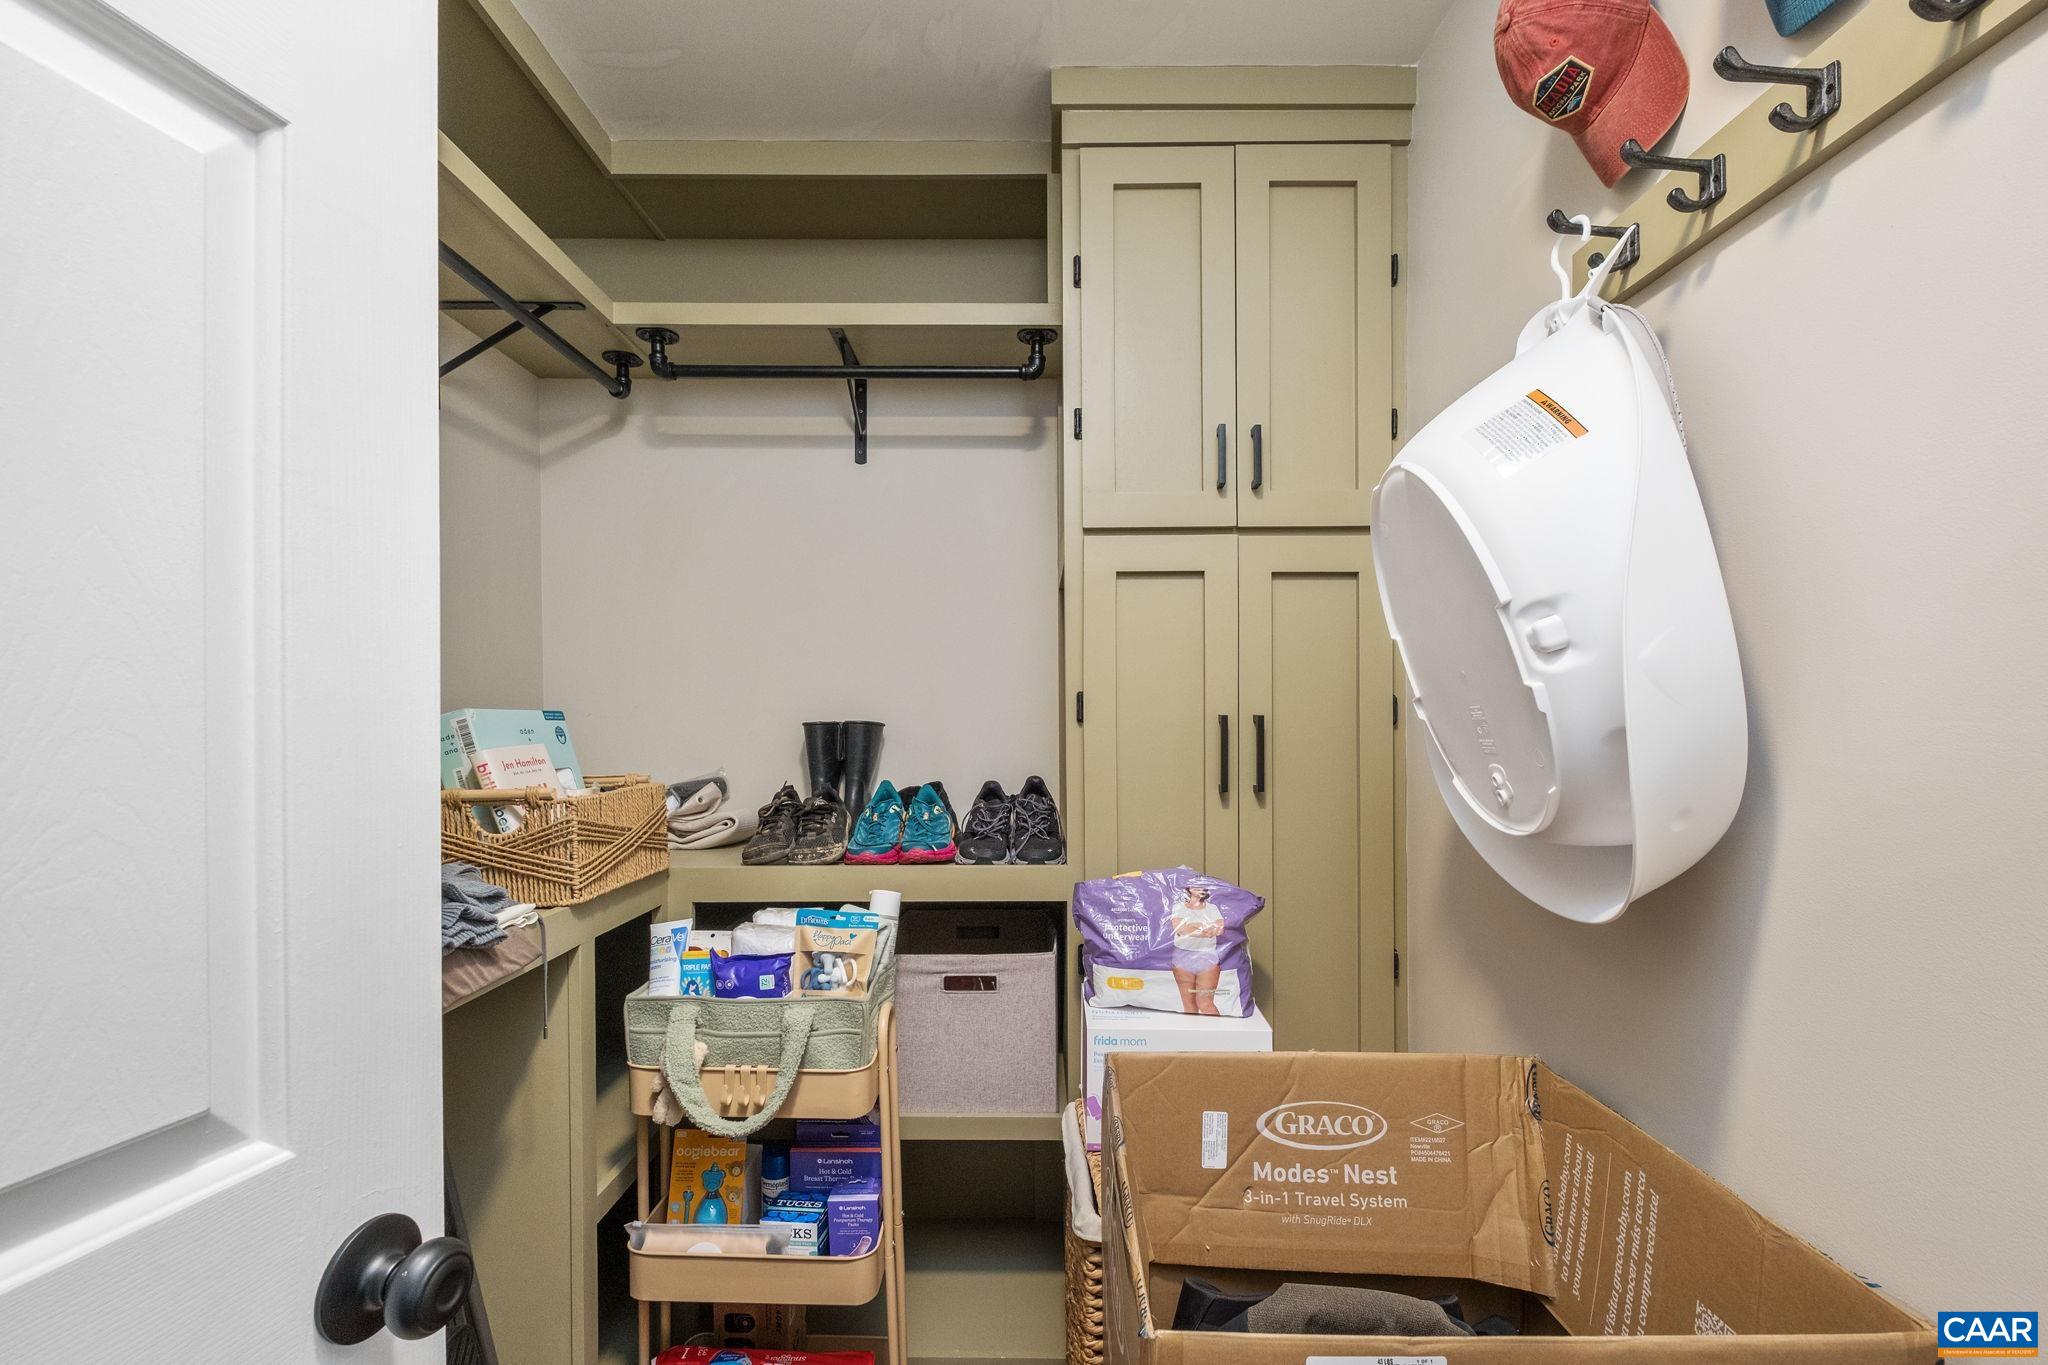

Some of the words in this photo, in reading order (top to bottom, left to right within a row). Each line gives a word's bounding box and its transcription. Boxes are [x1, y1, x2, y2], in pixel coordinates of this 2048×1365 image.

[1571, 70, 1587, 91] PARK
[1546, 400, 1573, 425] WARNING
[519, 727, 536, 735] aden
[502, 760, 515, 772] Jen
[514, 755, 547, 769] Hamilton
[651, 931, 685, 946] CeraVe
[683, 963, 700, 971] TRIPLE
[761, 978, 768, 987] 72
[1093, 1035, 1118, 1046] frida
[1119, 1038, 1147, 1046] mom
[676, 1145, 740, 1160] oogiebear
[1343, 1163, 1398, 1185] Nest
[1572, 1143, 1584, 1187] about
[1555, 1132, 1573, 1243] gracobaby.com
[1584, 1150, 1595, 1207] arrival!
[776, 1199, 823, 1208] TUCKS
[1243, 1188, 1289, 1205] 3-in-1
[1295, 1191, 1346, 1207] Travel
[1349, 1193, 1408, 1210] System
[1569, 1187, 1579, 1227] more
[1635, 1169, 1647, 1225] acerca
[1281, 1214, 1301, 1225] with
[1353, 1216, 1374, 1226] DLX
[791, 1228, 812, 1240] KS
[1577, 1206, 1590, 1261] newest
[1613, 1170, 1633, 1293] gracobaby.com
[1630, 1224, 1641, 1261] más
[1562, 1227, 1574, 1266] learn
[1638, 1261, 1653, 1326] compra
[1646, 1188, 1660, 1262] reciente!
[1560, 1265, 1569, 1283] to
[1572, 1260, 1583, 1301] your
[1623, 1259, 1637, 1325] conocer
